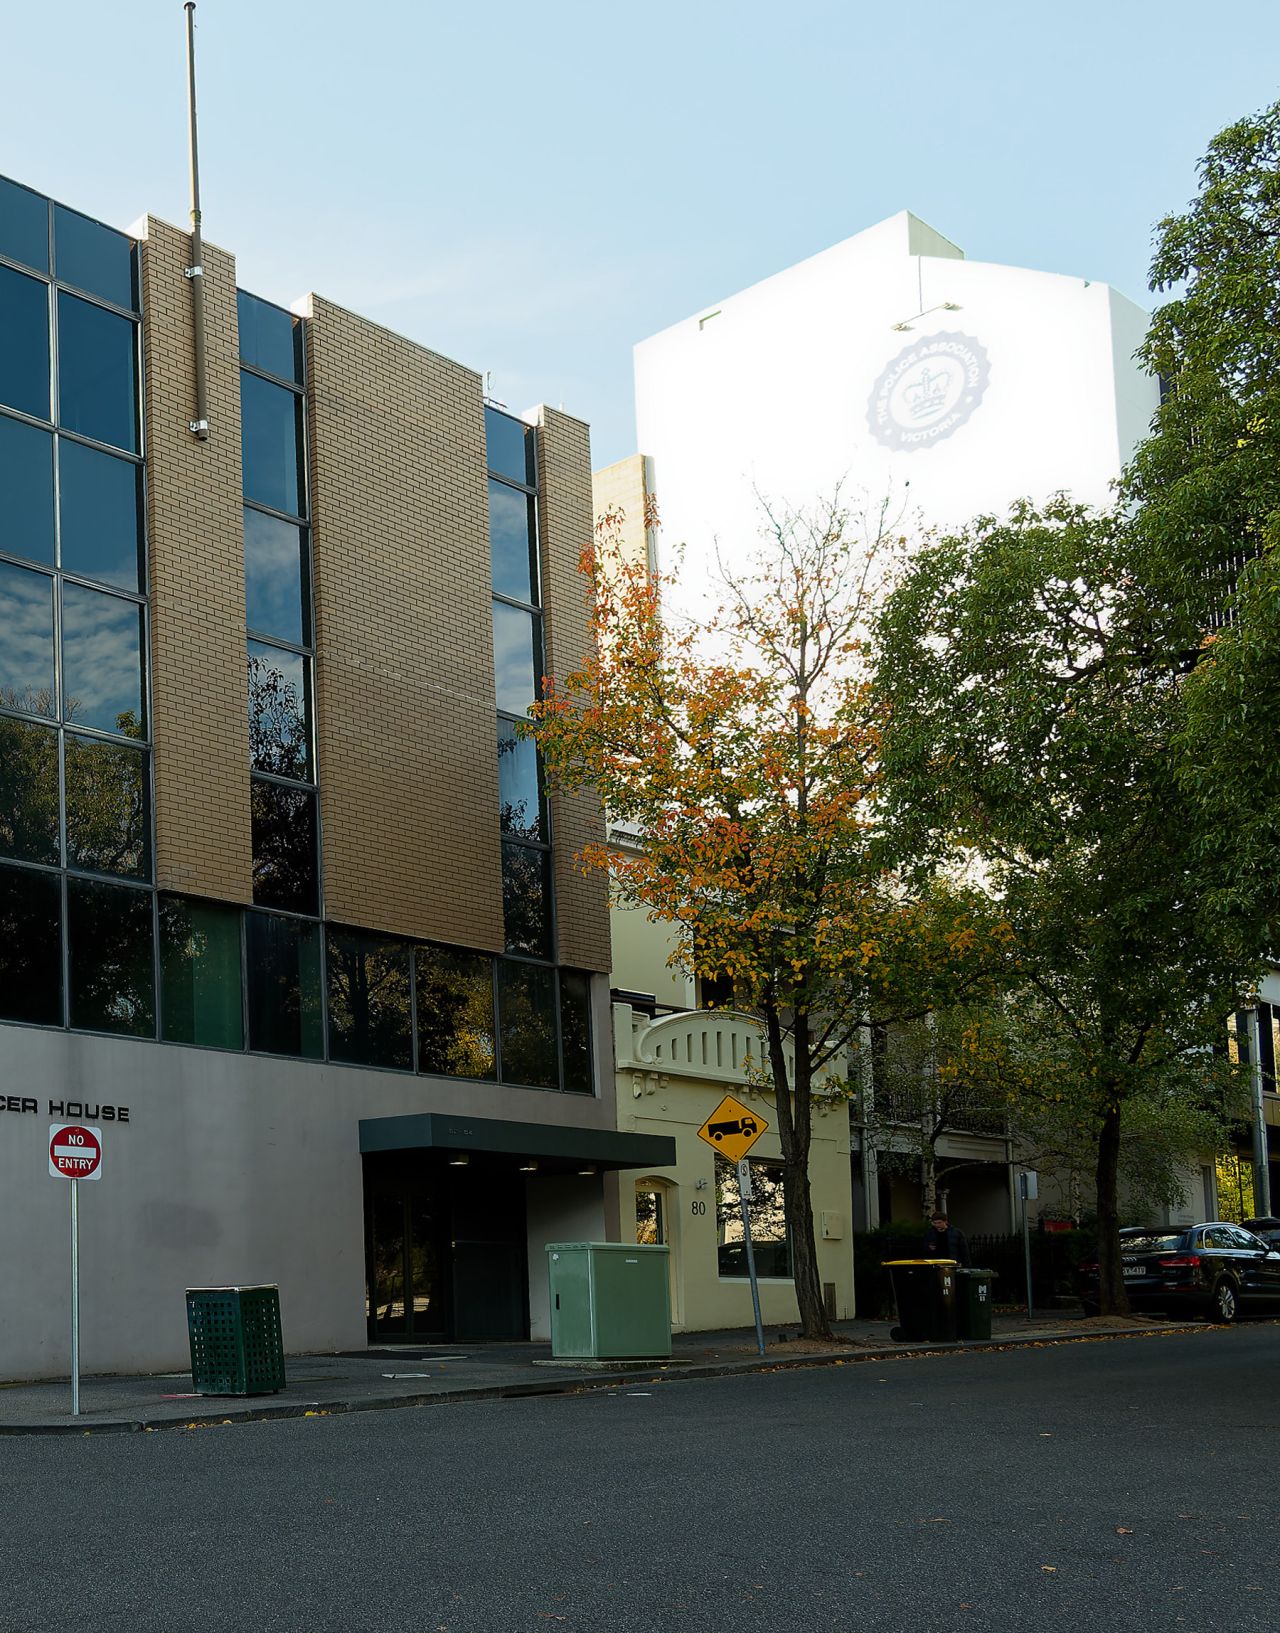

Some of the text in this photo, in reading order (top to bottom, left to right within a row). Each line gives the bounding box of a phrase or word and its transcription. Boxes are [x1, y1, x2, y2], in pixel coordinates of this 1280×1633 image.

[876, 342, 981, 424] THE POLICE ASSOCIATION
[900, 413, 962, 442] VICTORIA
[48, 1100, 130, 1122] HOUSE
[68, 1134, 85, 1146] NO
[58, 1158, 94, 1170] ENTRY
[691, 1201, 706, 1216] 80
